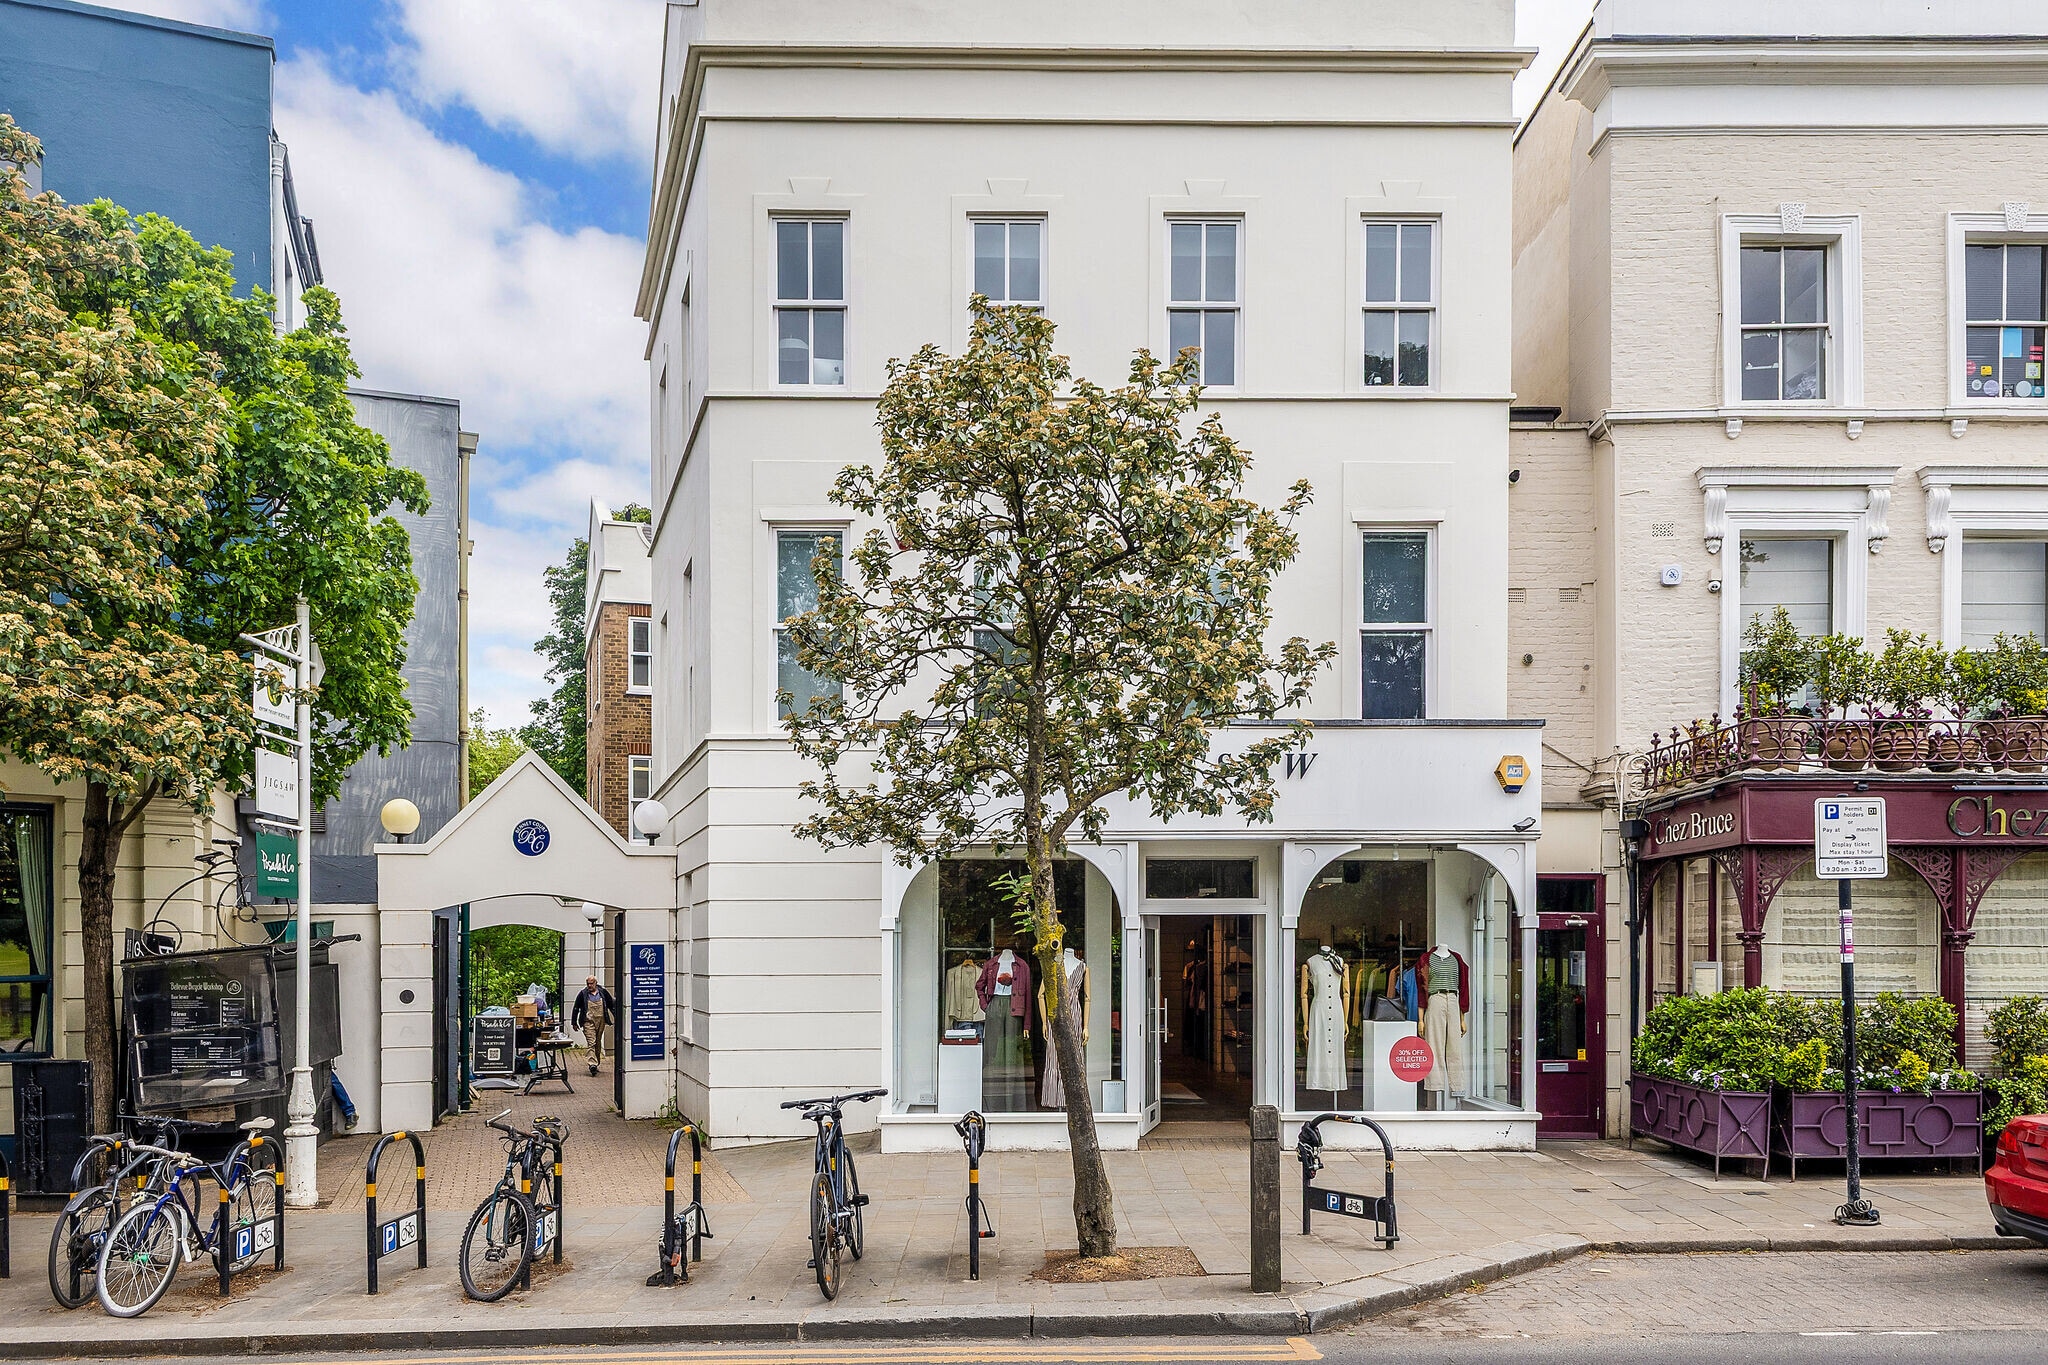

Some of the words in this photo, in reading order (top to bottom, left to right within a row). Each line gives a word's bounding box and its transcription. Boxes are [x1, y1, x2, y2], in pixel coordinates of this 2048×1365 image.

[1508, 767, 1522, 775] ADT
[263, 776, 295, 792] JIGSAW
[1827, 806, 1837, 818] P
[1946, 795, 2048, 837] Chez
[514, 821, 532, 834] BENNET
[1655, 817, 1687, 845] Chez
[1690, 812, 1733, 839] Bruce
[203, 981, 224, 992] Workshop
[1329, 1195, 1338, 1208] P
[385, 1225, 395, 1252] P
[239, 1234, 249, 1258] P
